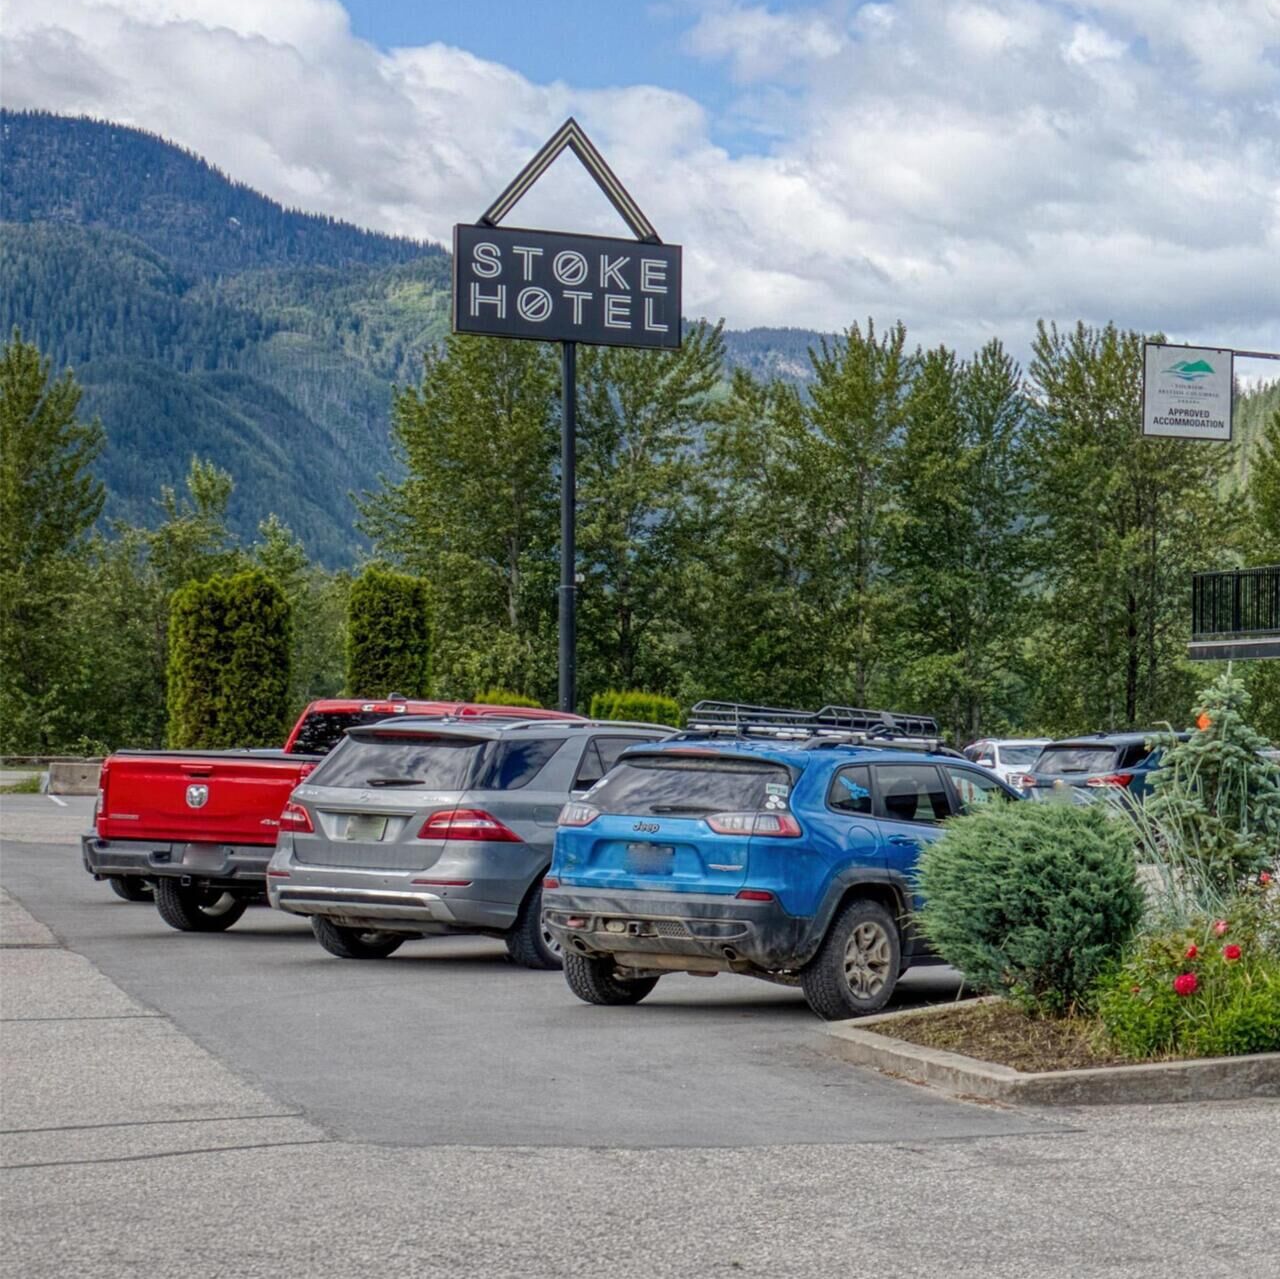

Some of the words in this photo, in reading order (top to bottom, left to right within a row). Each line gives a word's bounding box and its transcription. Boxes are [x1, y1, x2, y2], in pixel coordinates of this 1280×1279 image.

[1168, 407, 1210, 419] APPROVED
[1153, 416, 1225, 429] ACCOMMODATION
[633, 821, 660, 834] Jeep
